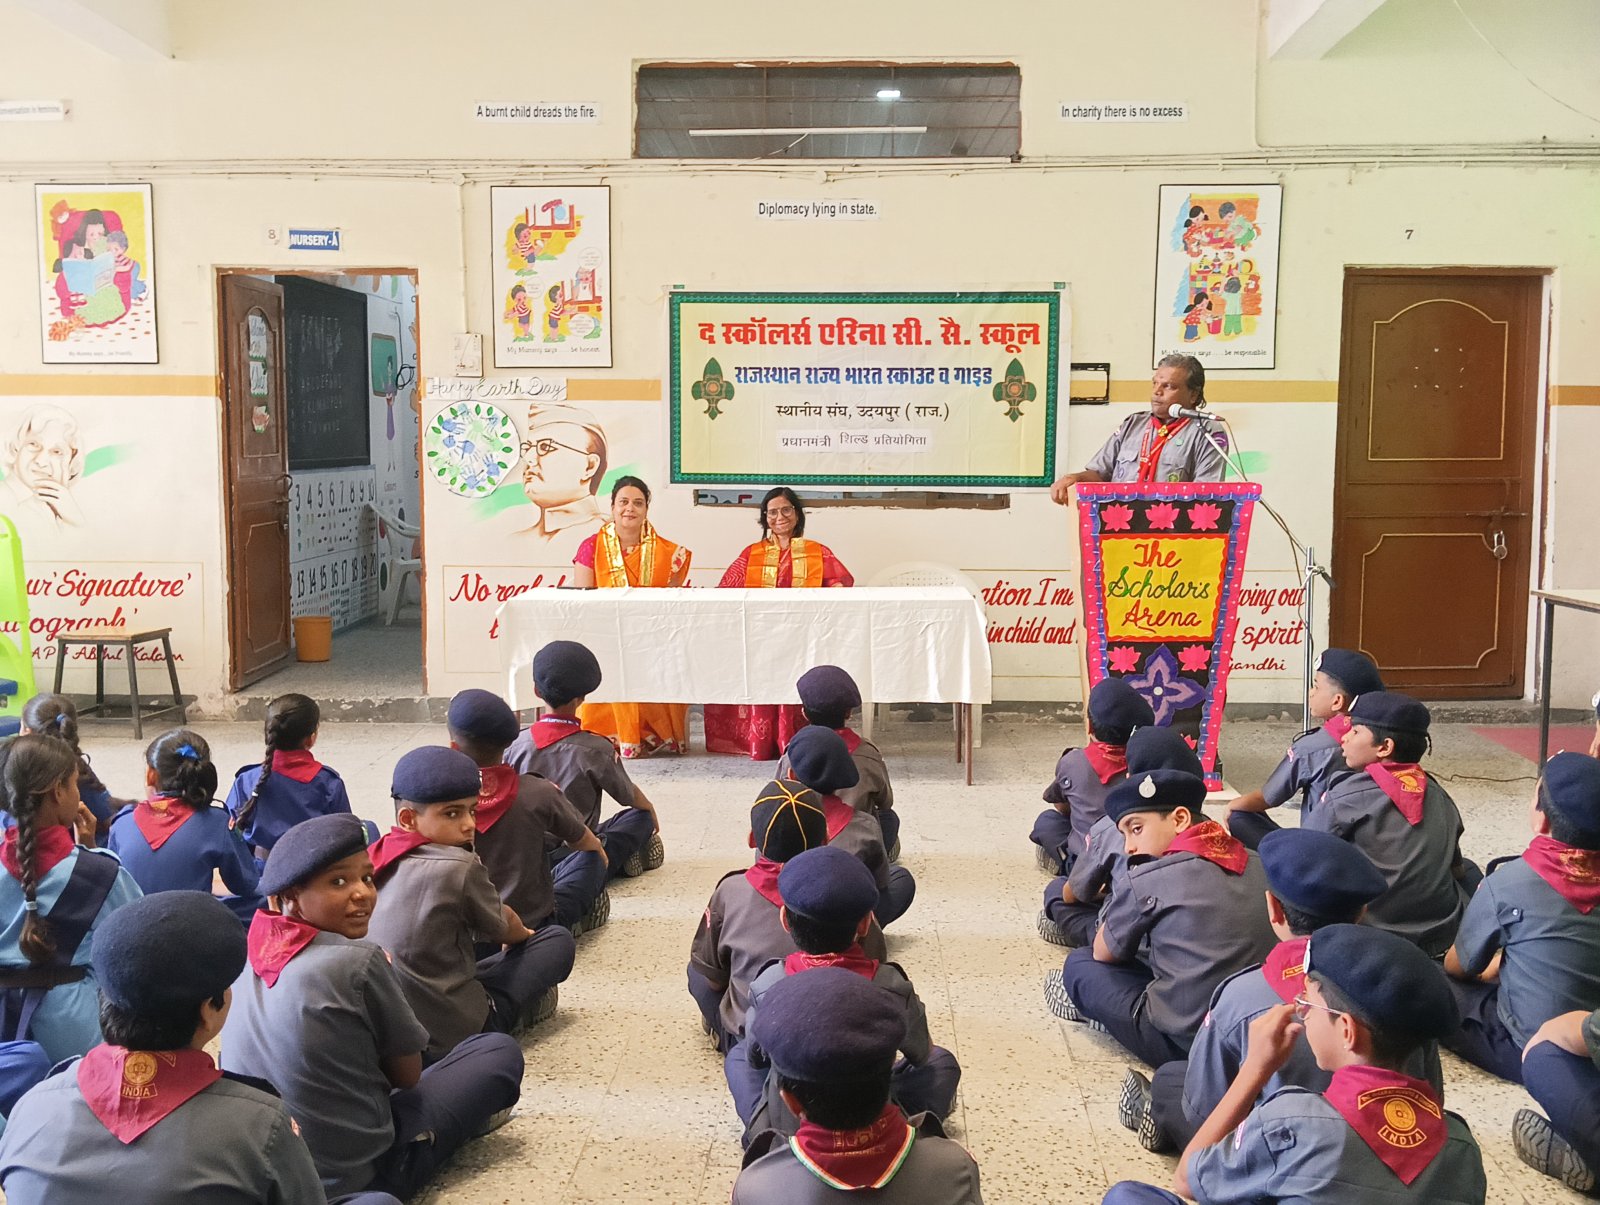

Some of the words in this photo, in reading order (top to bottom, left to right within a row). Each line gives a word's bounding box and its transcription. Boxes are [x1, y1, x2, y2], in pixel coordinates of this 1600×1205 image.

[477, 105, 483, 117] A
[485, 105, 508, 117] burnt
[510, 105, 531, 117] child
[533, 105, 562, 117] dreads
[564, 105, 578, 117] the
[580, 105, 597, 117] fire.
[1061, 105, 1070, 117] In
[1072, 105, 1102, 120] charity
[1104, 105, 1127, 117] there
[1129, 105, 1137, 117] is
[1139, 107, 1150, 117] no
[1153, 106, 1183, 117] excess
[758, 202, 810, 217] Diplomacy
[813, 202, 836, 217] lying
[839, 202, 848, 214] in
[850, 203, 877, 215] state.
[1405, 229, 1414, 240] 7
[698, 323, 715, 345] द
[722, 317, 811, 345] स्कॉलर्स
[818, 317, 887, 345] एरिना
[979, 323, 1041, 353] स्कूल
[735, 366, 800, 384] राजस्थान
[805, 367, 841, 384] राज्य
[845, 367, 882, 385] भारत
[887, 367, 935, 384] स्काउट
[938, 367, 950, 384] व
[954, 367, 993, 387] गाइड
[476, 377, 525, 397] Earth
[525, 377, 566, 400] Day
[776, 401, 822, 417] स्थानीय
[857, 405, 900, 422] उदयपुर
[782, 435, 831, 447] प्रधानमंत्री
[874, 434, 927, 446] प्रतियोगिता
[307, 484, 312, 509] 4
[318, 482, 323, 508] 5
[329, 481, 335, 506] 6
[1134, 540, 1182, 568] The
[297, 570, 304, 598] 13
[309, 568, 316, 594] 14
[320, 565, 327, 591] 15
[331, 562, 338, 588] 16
[449, 573, 491, 602] No
[1033, 578, 1056, 606] I
[1121, 599, 1202, 634] Arena
[988, 621, 1004, 643] in
[1004, 616, 1047, 643] child
[1043, 618, 1076, 644] and
[1241, 620, 1303, 651] spirit
[72, 646, 123, 660] Abul
[122, 1086, 151, 1098] INDIA
[1383, 1128, 1423, 1146] INDIA
